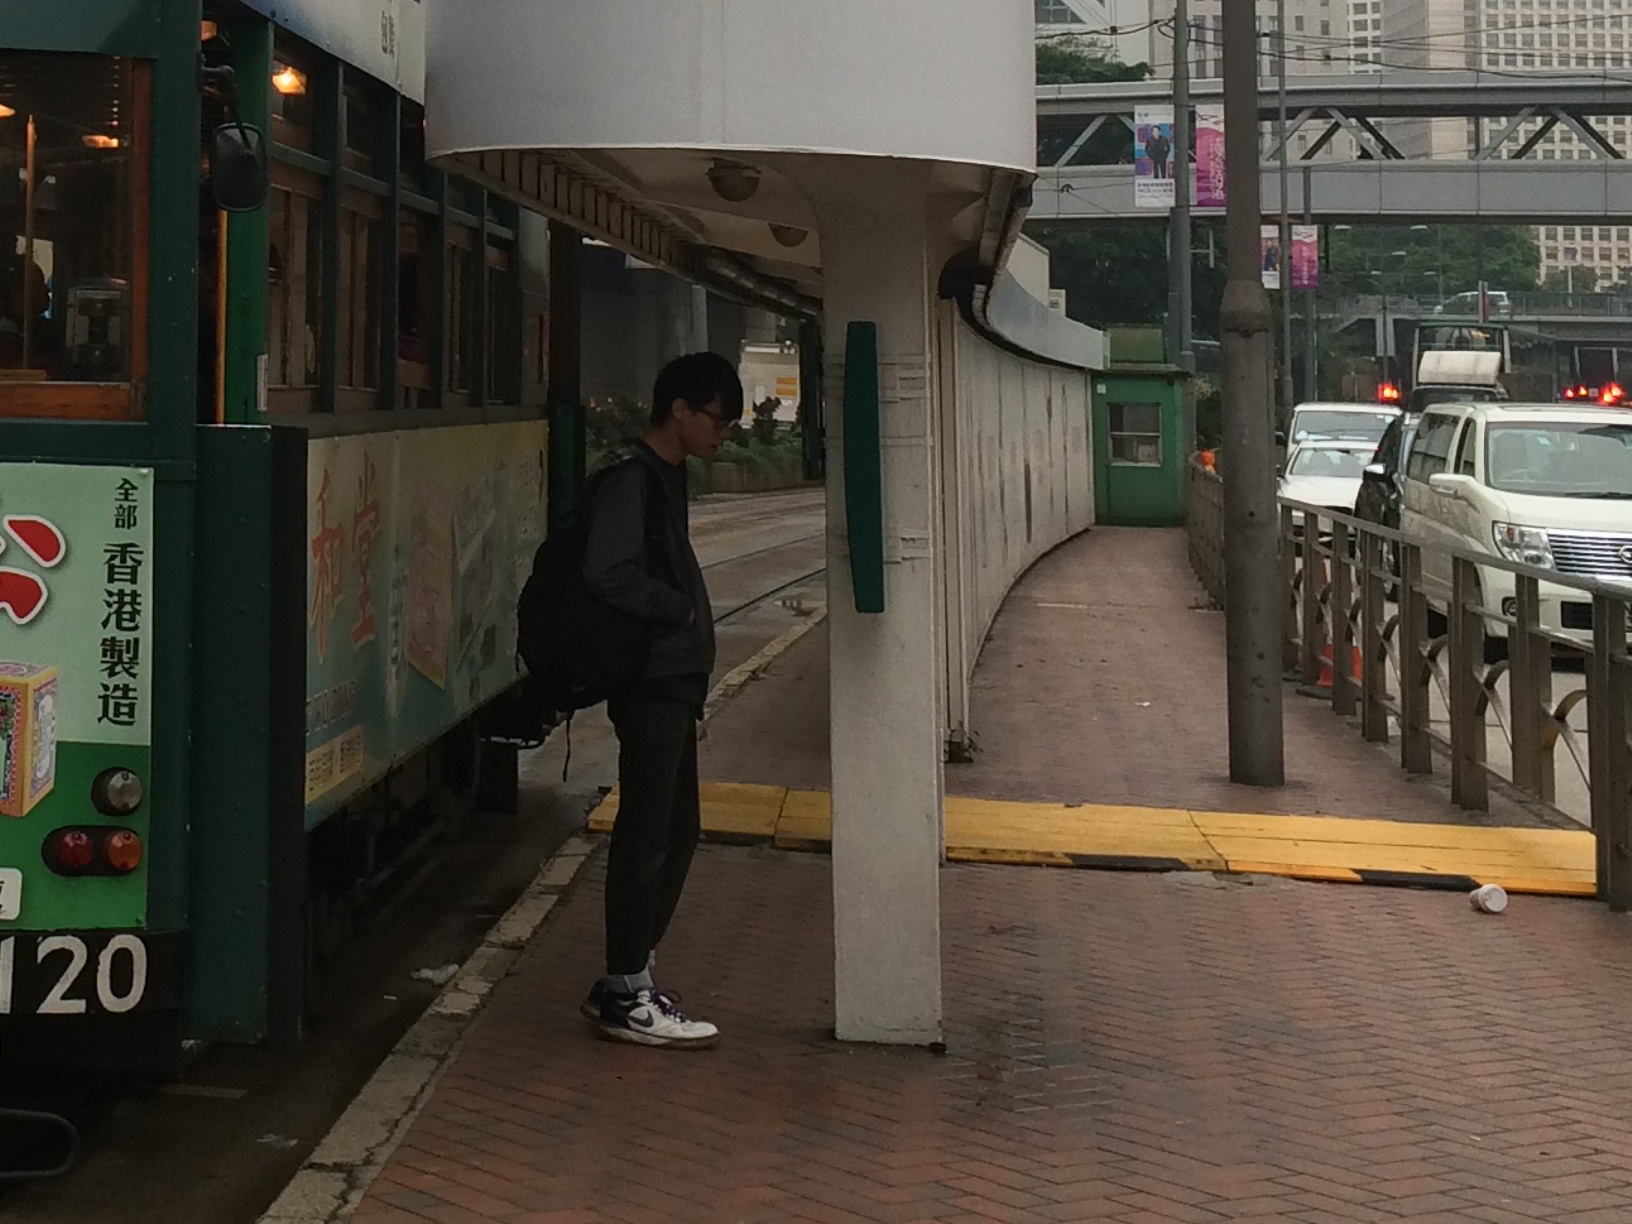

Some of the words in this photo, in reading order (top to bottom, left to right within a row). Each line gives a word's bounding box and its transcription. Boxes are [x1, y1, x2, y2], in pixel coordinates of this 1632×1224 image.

[114, 477, 139, 530] 全部
[97, 541, 145, 727] 香港製造
